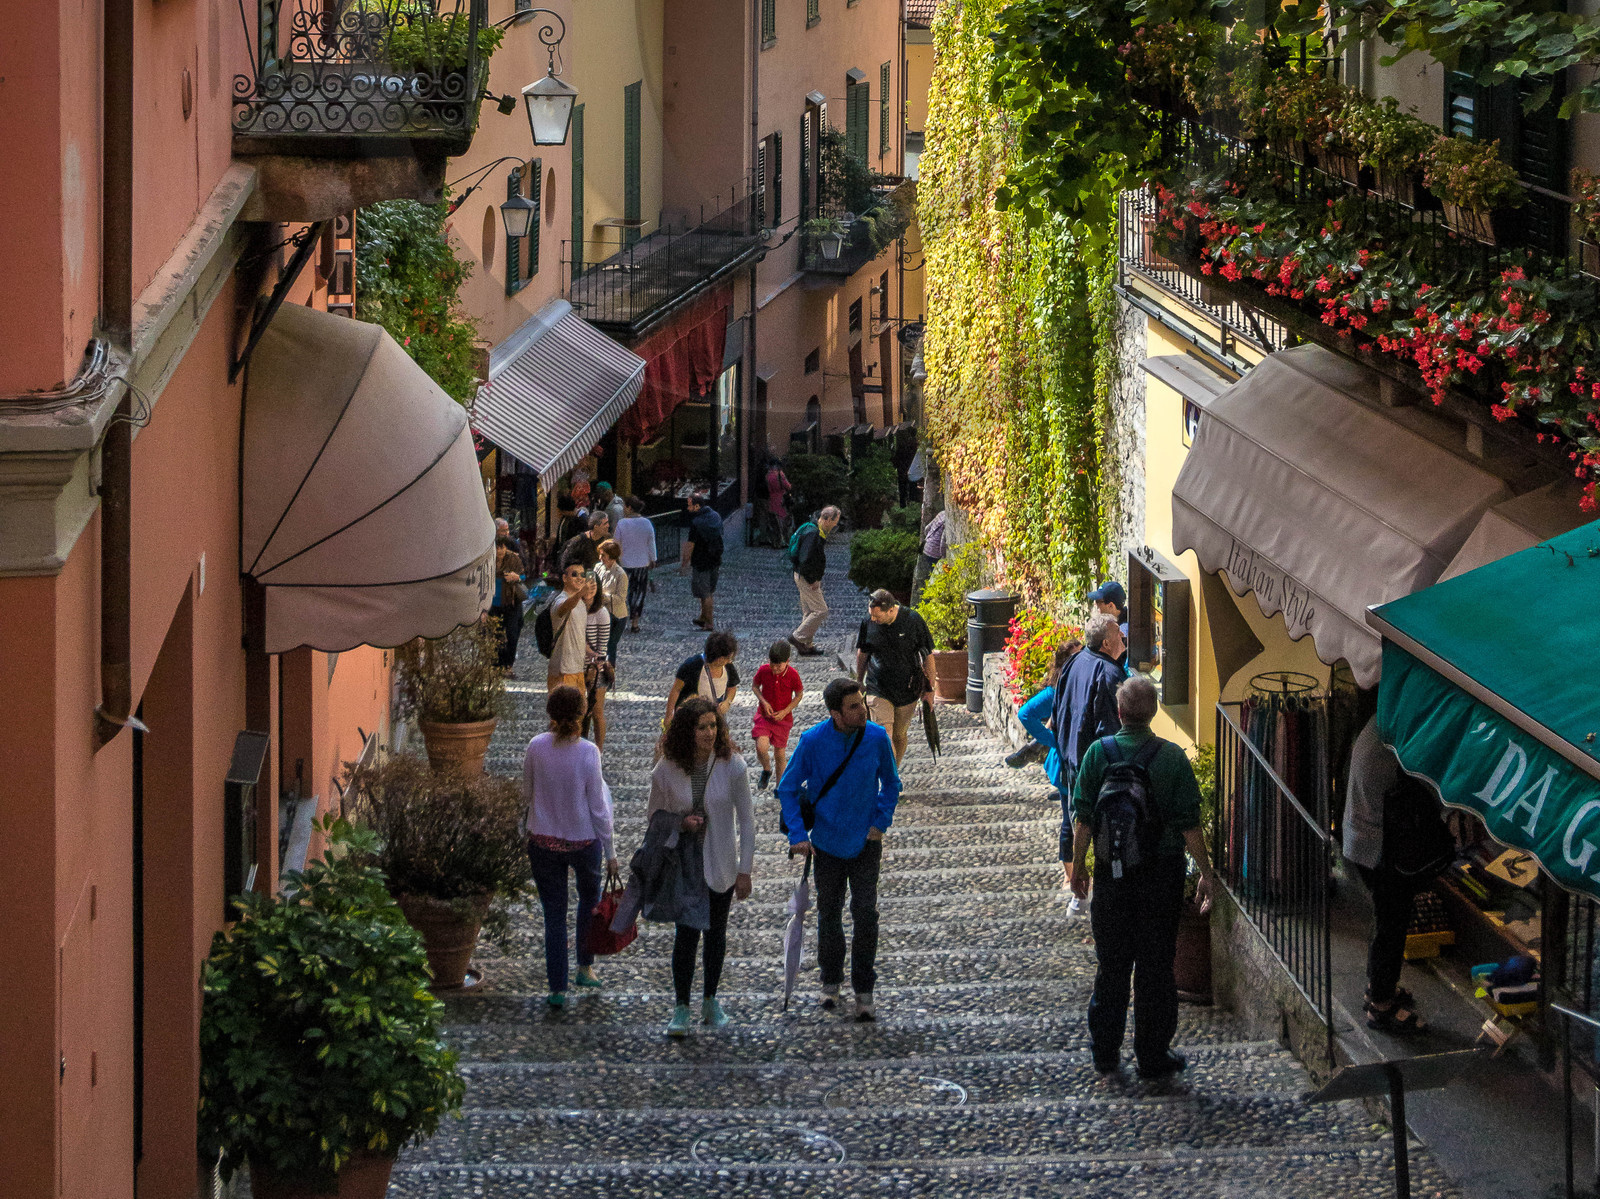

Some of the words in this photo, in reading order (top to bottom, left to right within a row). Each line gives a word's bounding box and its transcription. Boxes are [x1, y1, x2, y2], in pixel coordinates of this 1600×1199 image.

[1224, 537, 1274, 601] Italian
[1277, 574, 1315, 631] Style
[1562, 800, 1600, 883] G
